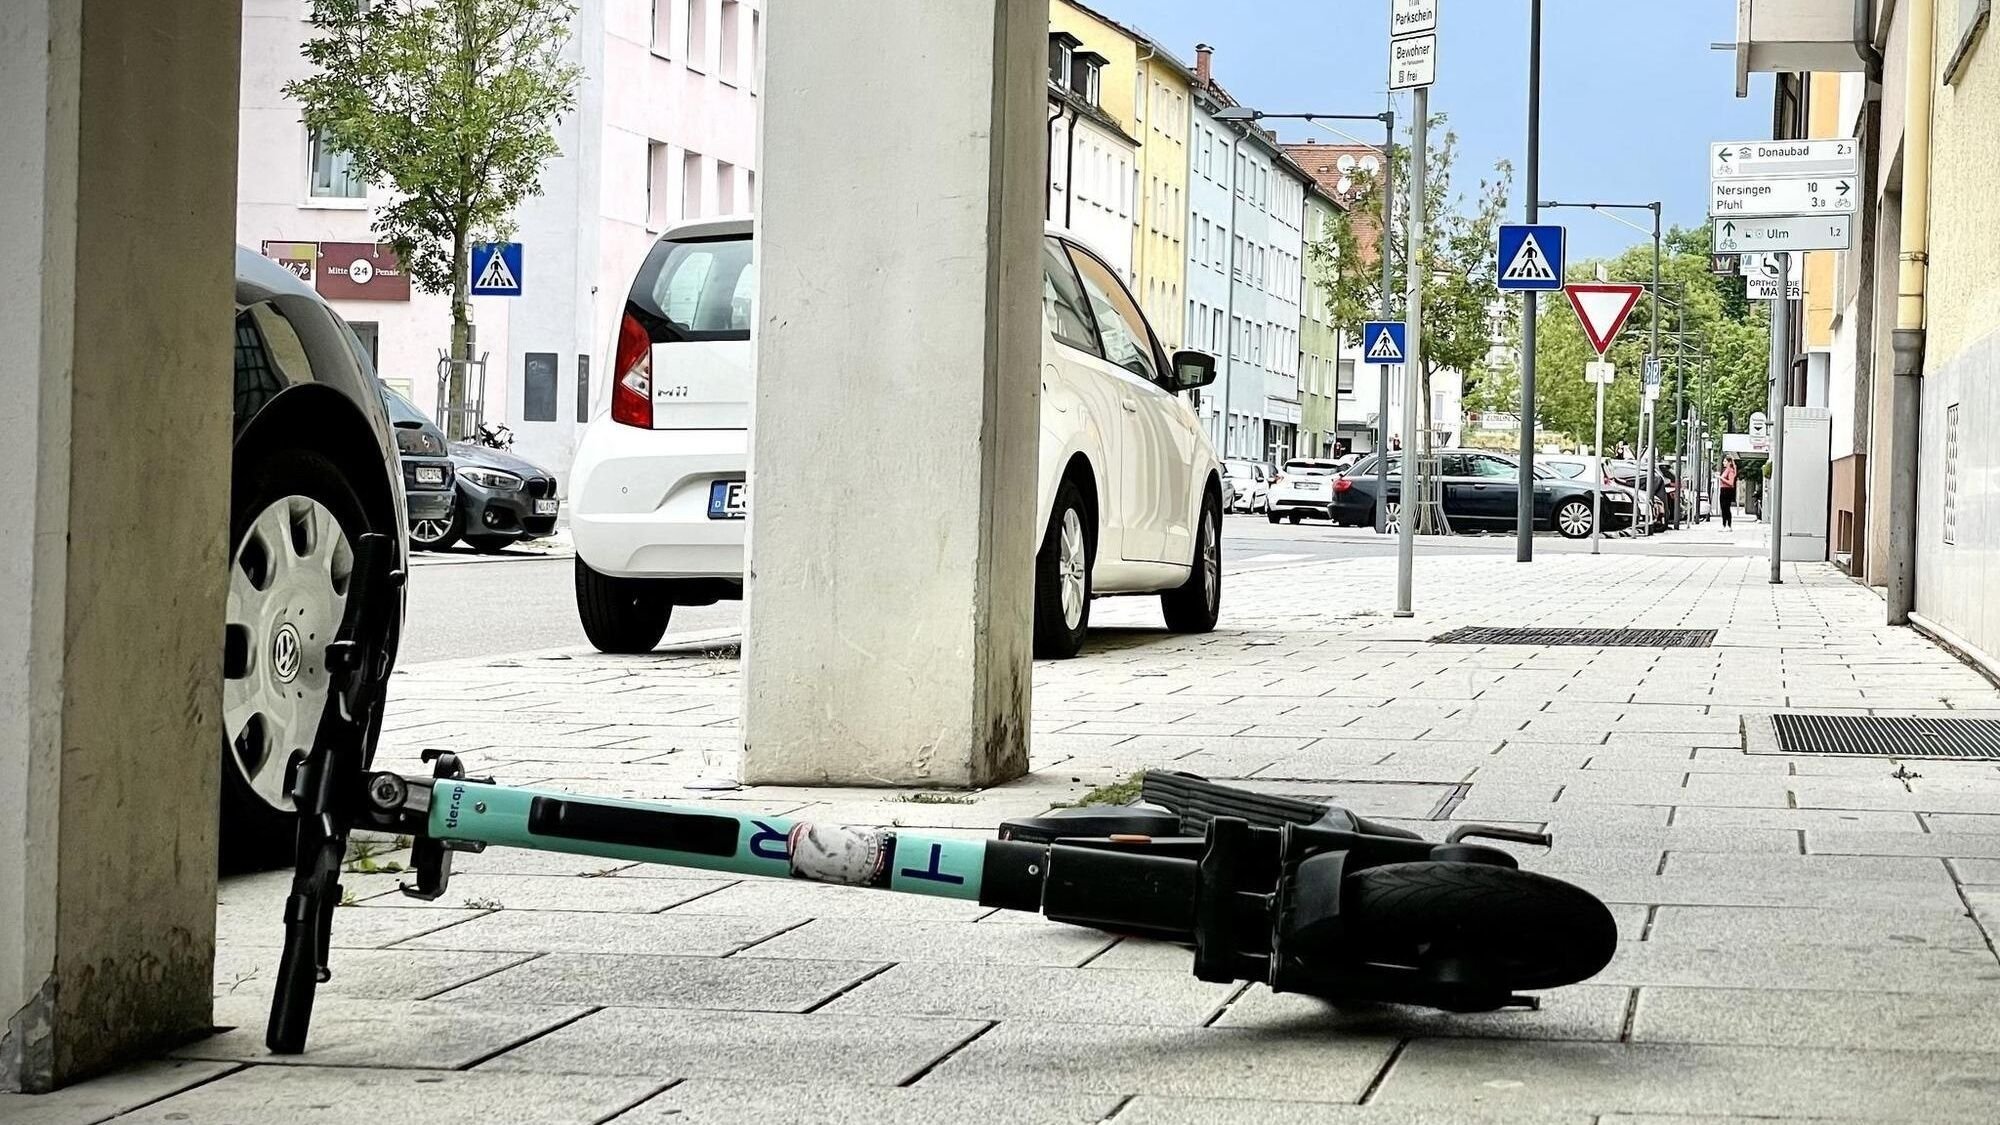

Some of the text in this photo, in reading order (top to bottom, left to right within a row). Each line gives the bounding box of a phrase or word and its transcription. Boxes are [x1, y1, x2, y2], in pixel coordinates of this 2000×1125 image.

[1396, 10, 1432, 25] Parkschein
[1397, 45, 1430, 59] Bewohner
[1758, 146, 1809, 157] Donaubad
[1717, 182, 1818, 197] Nersingen 10
[1716, 200, 1743, 210] Pfuhl
[1767, 229, 1789, 239] Ulm
[328, 267, 348, 275] Mitte
[353, 266, 369, 277] 24
[1750, 279, 1799, 287] ORTHODIE
[1760, 287, 1800, 297] MAER
[727, 484, 746, 509] E
